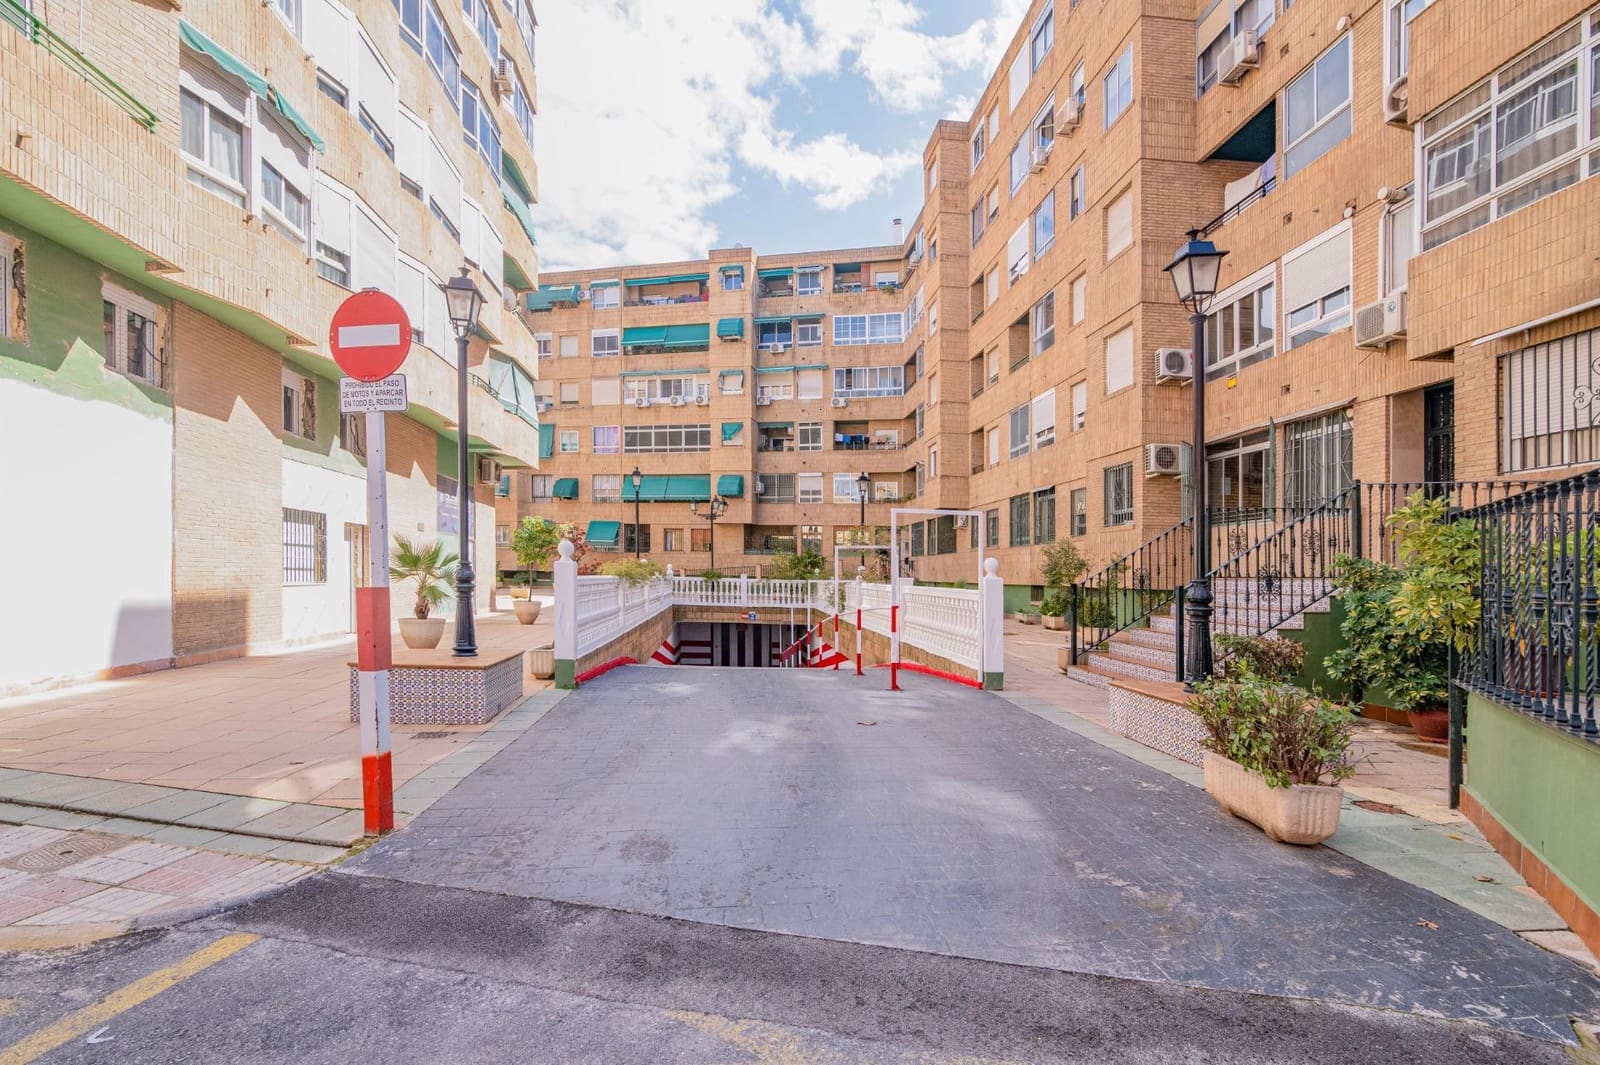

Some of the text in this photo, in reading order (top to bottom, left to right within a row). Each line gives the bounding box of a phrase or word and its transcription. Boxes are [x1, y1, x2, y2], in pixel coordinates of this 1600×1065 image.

[383, 379, 400, 387] PASO
[343, 391, 350, 399] DE
[344, 398, 403, 408] EN TODO EL RECINTO
